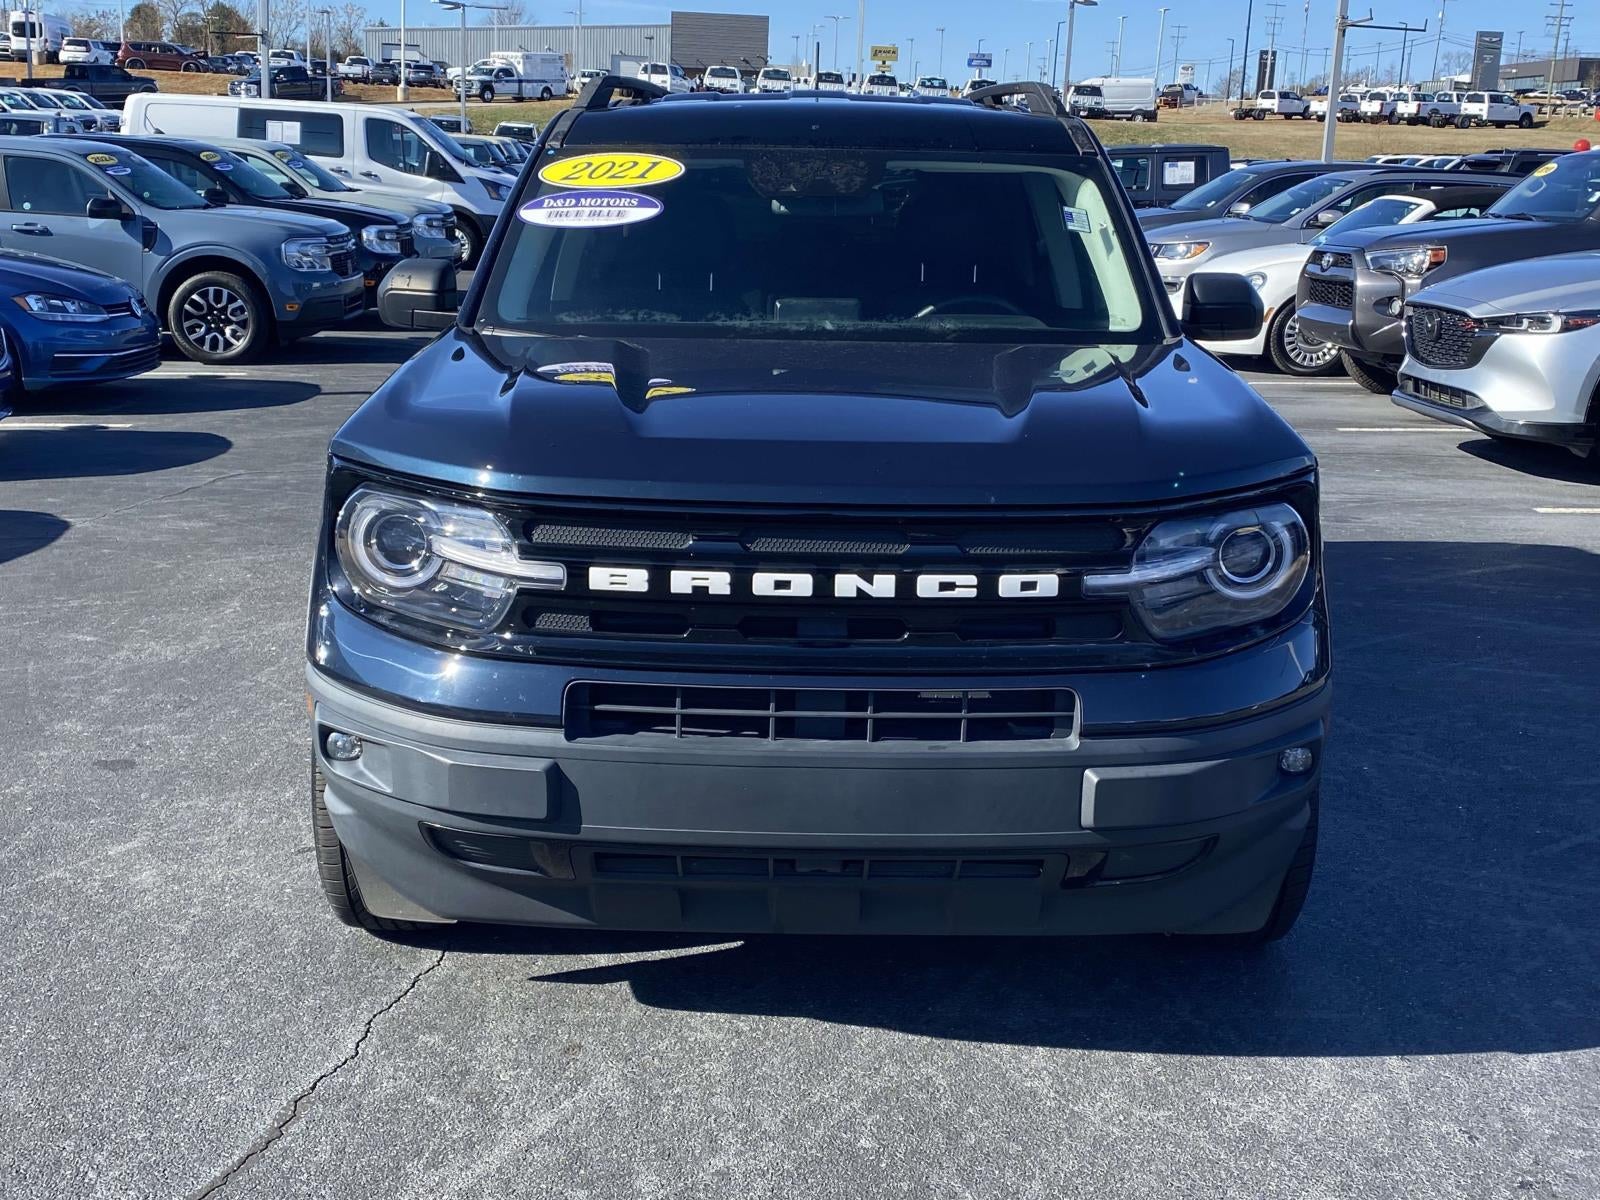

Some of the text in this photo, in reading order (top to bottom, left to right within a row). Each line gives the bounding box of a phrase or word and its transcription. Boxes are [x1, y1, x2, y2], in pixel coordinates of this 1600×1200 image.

[561, 161, 662, 180] 2021
[542, 198, 639, 208] D&D MOTORS
[547, 209, 627, 218] TRUE BLUE
[588, 566, 1059, 598] BRONCO
